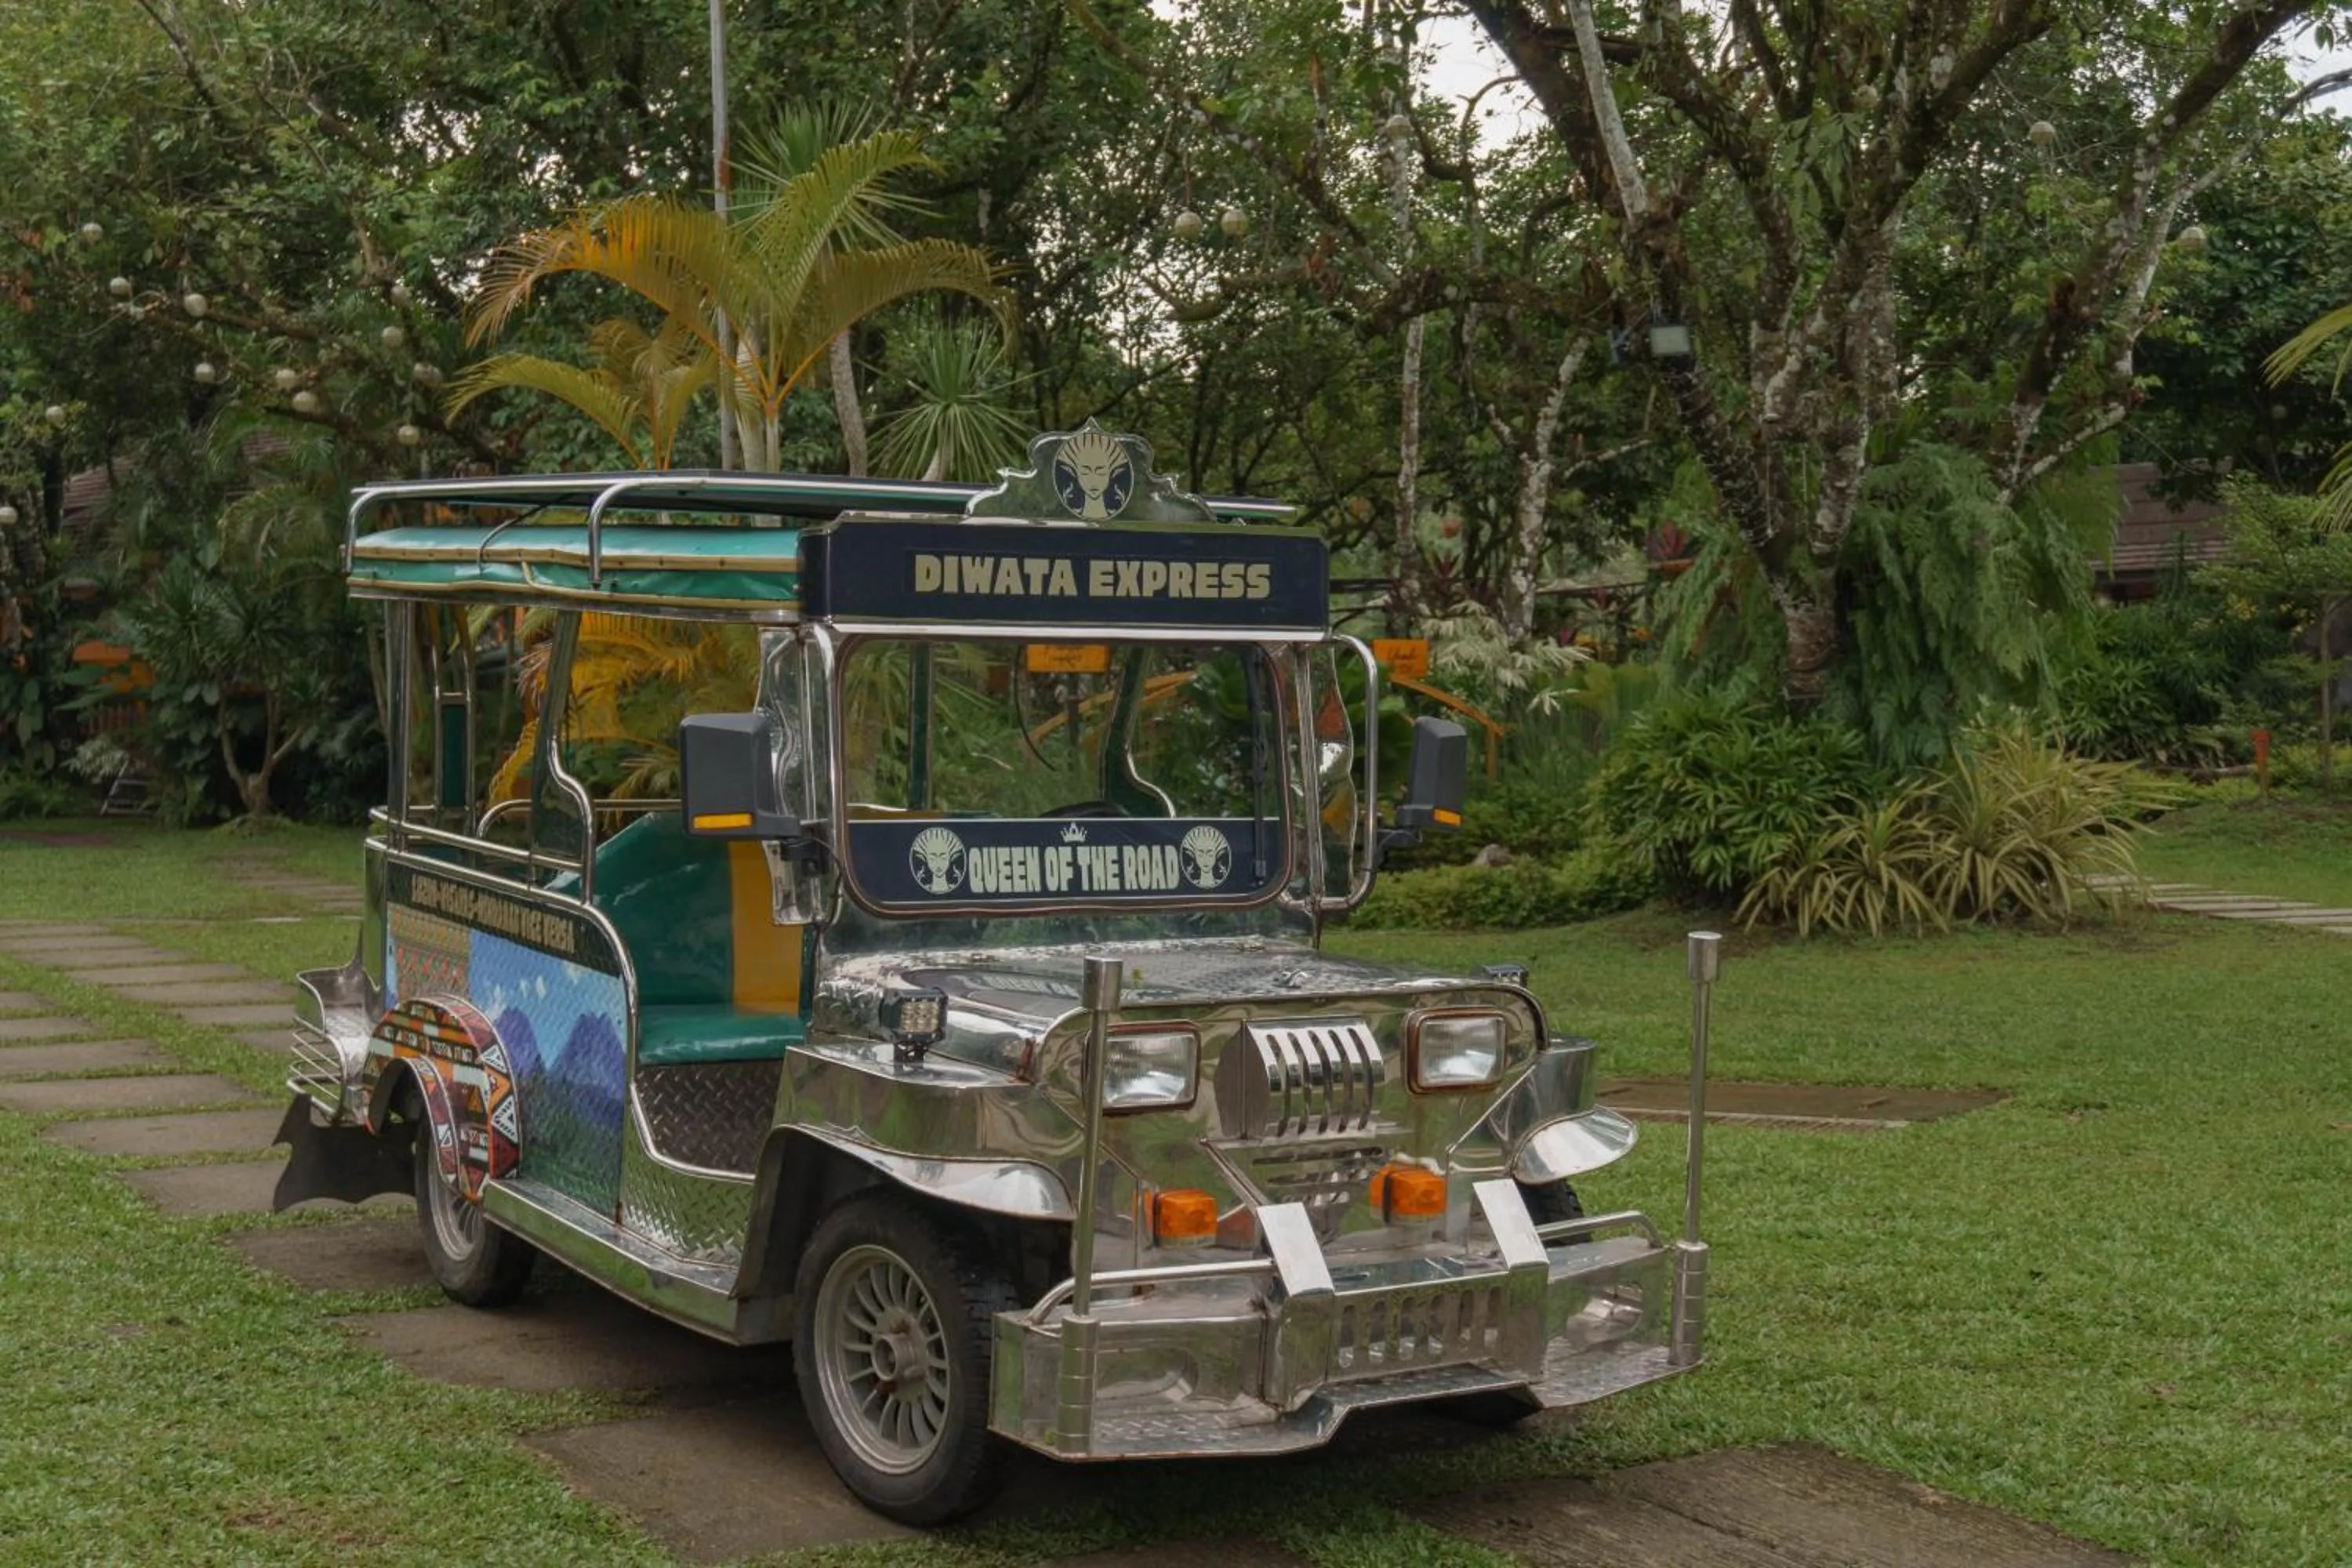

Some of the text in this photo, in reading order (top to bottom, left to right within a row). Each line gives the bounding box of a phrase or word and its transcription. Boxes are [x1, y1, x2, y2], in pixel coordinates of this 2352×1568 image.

[914, 554, 1271, 599] DIWATA EXPRESS
[968, 844, 1180, 893] QUEEN OF THE ROAD
